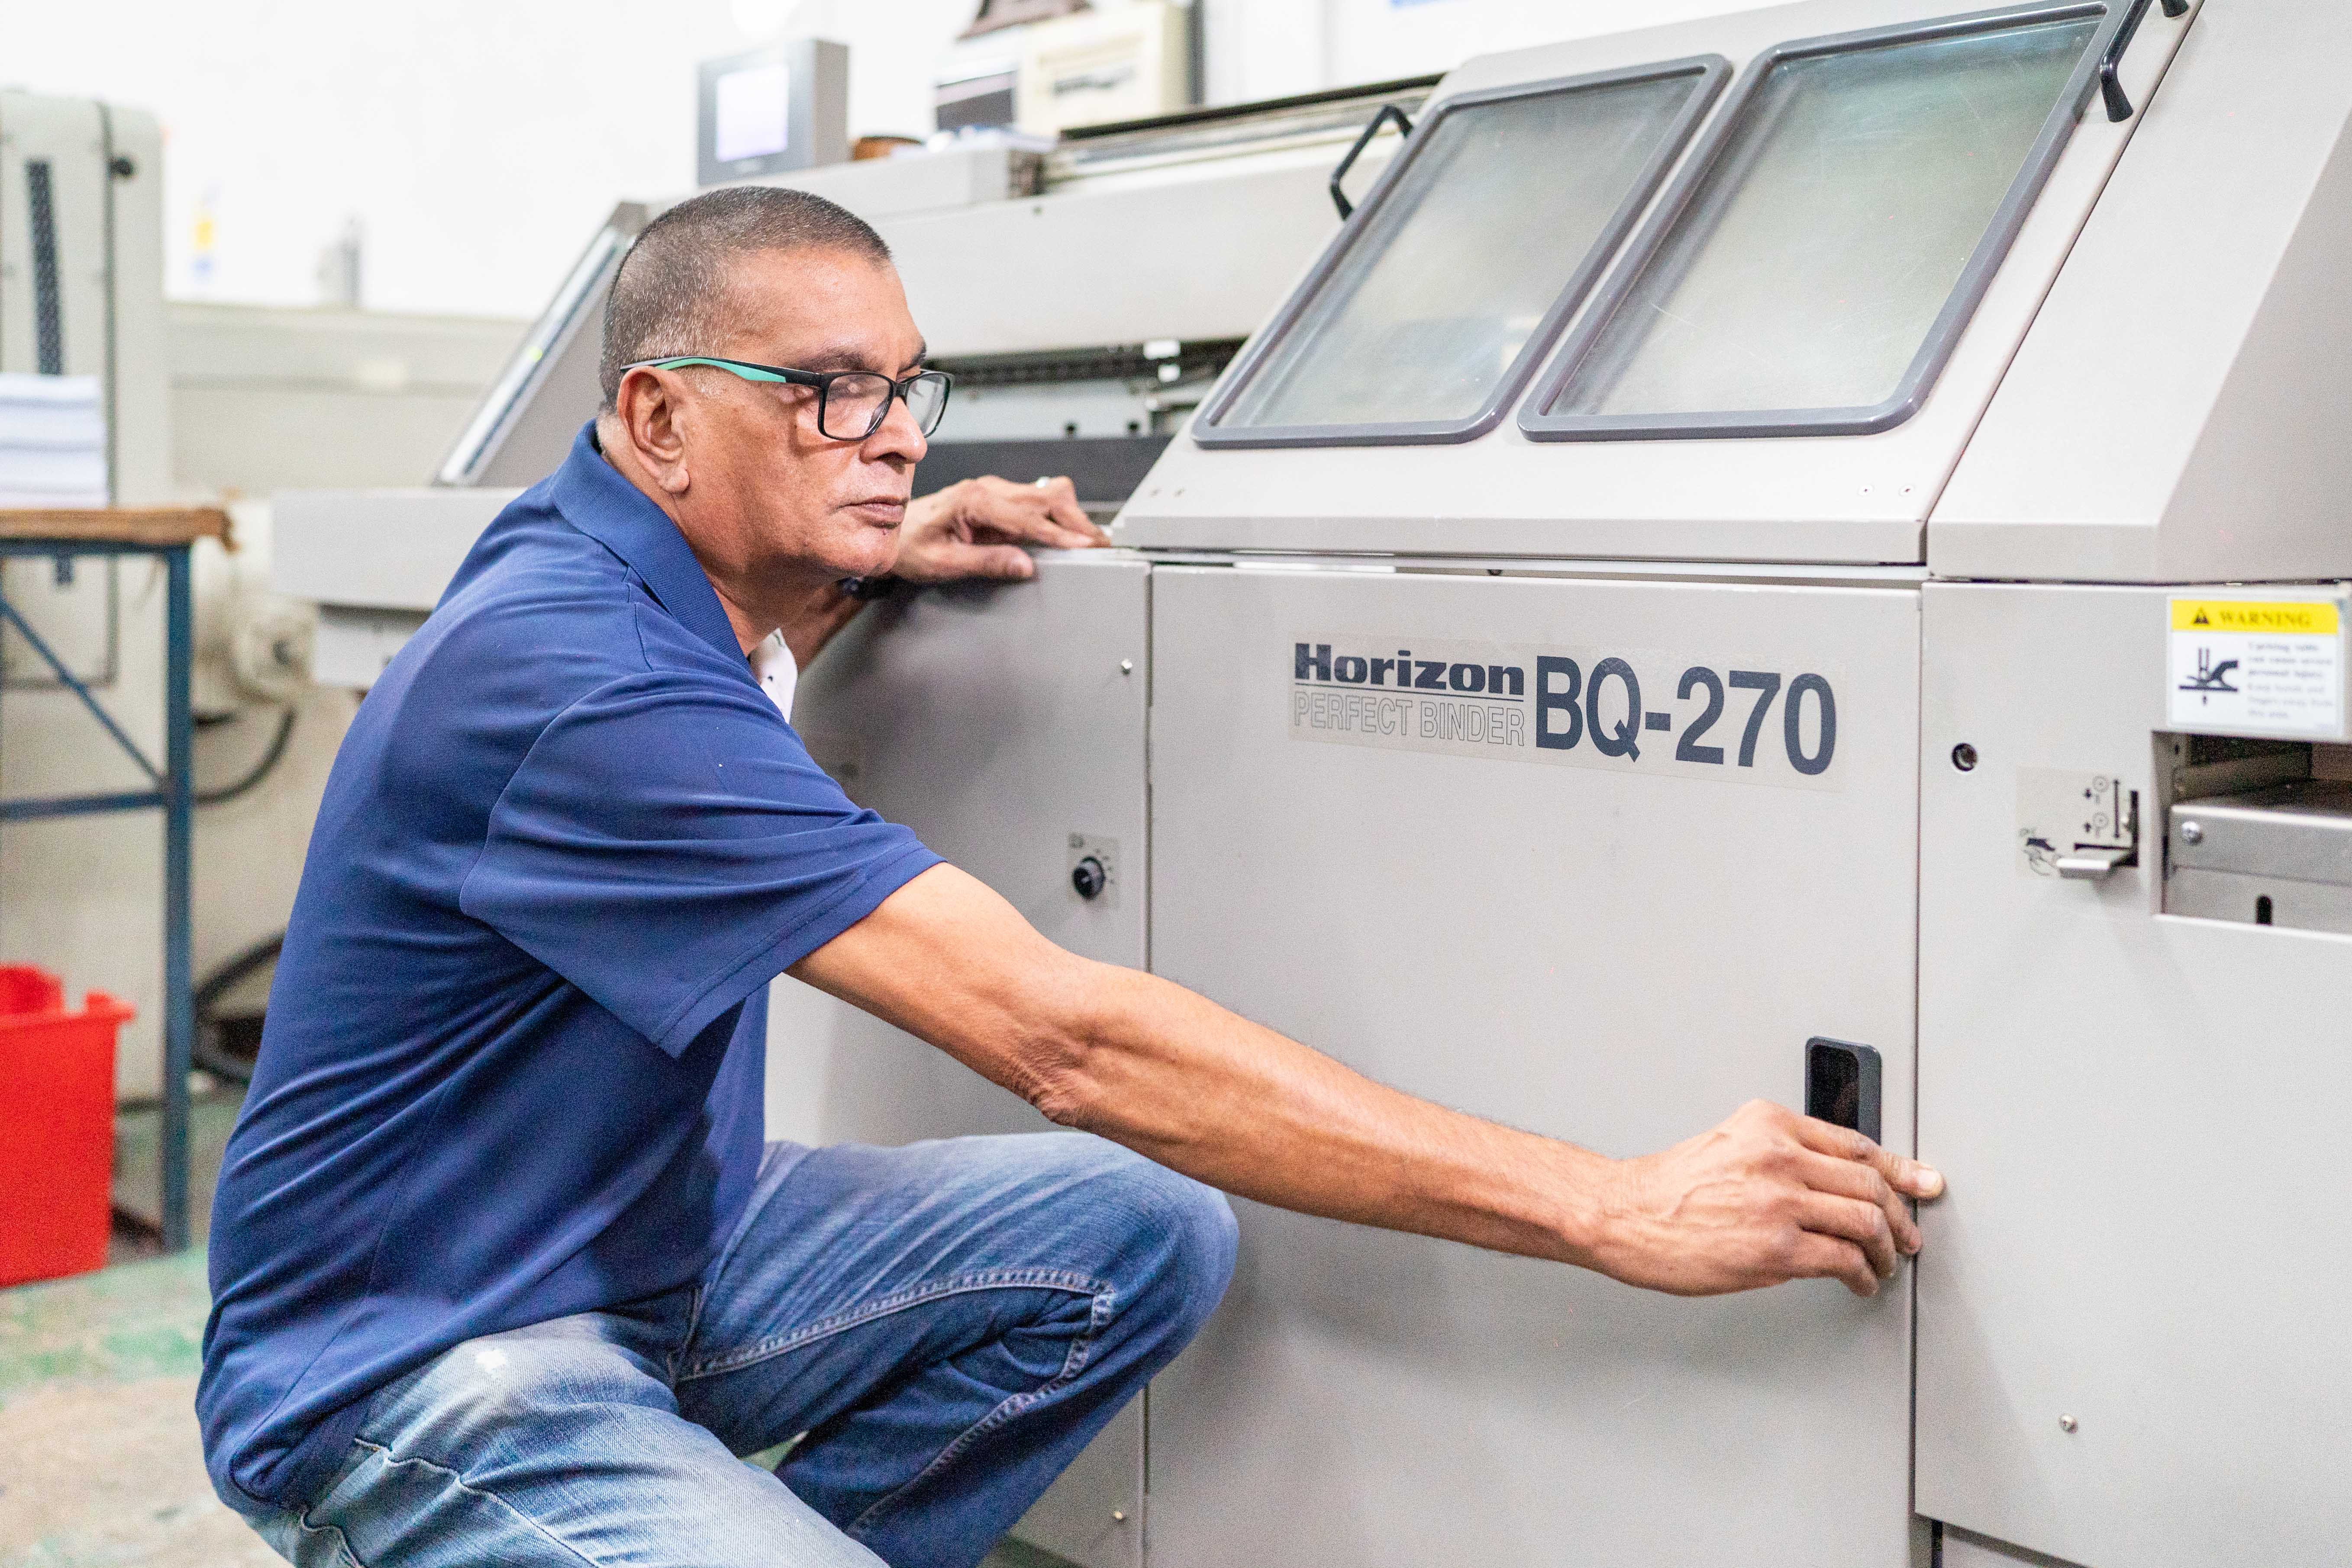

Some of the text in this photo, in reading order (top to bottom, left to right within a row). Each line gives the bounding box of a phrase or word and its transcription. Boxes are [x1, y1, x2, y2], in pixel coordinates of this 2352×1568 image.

[2219, 610, 2312, 626] WARNING
[1294, 642, 1524, 696] Horizon
[1294, 690, 1525, 746] PERFECT BINDER
[1536, 655, 1836, 775] BQ-270
